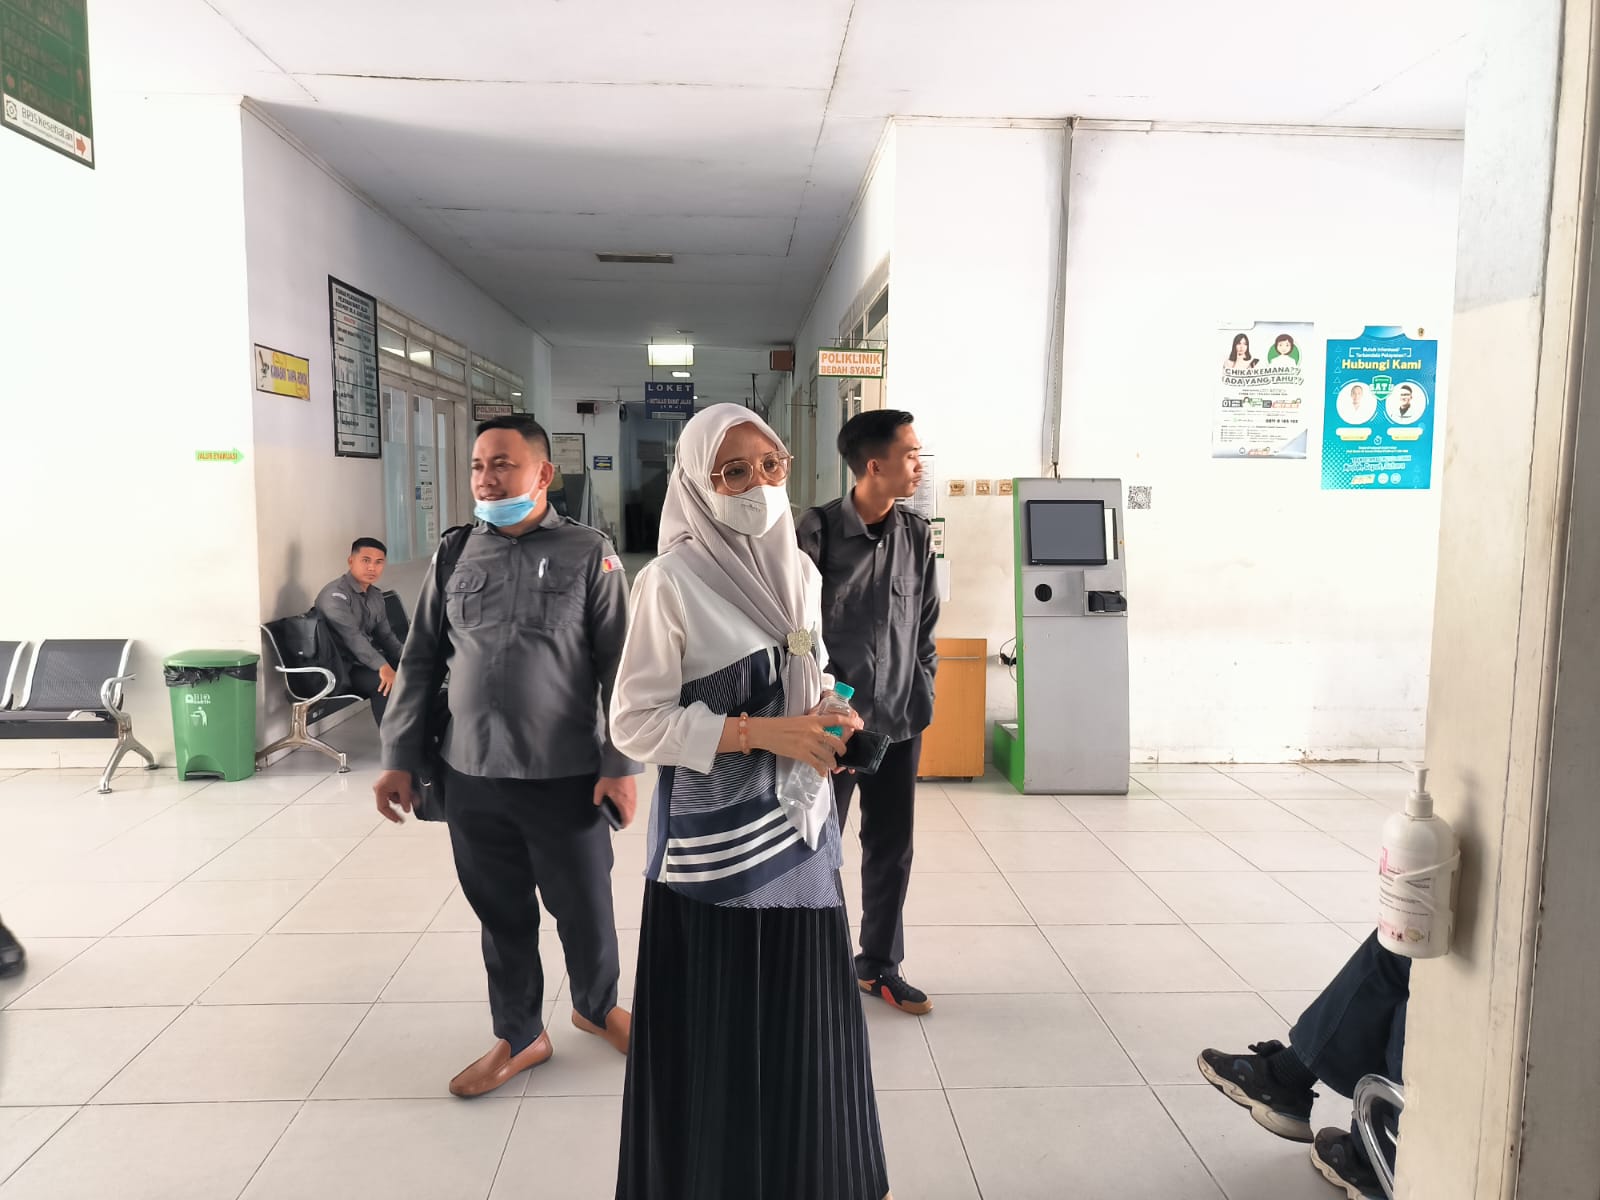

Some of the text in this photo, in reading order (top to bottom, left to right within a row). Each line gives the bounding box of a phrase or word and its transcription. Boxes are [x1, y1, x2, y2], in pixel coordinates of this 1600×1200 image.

[22, 107, 38, 123] BPJS
[38, 118, 73, 141] Kesehatan
[821, 353, 880, 364] POLIKLINIK
[1342, 359, 1422, 371] Hubungi Kami
[821, 366, 880, 375] BEDAH SYARAF
[1225, 368, 1252, 376] CHIKA
[1224, 377, 1244, 385] ADA
[1245, 377, 1270, 385] YANG
[647, 384, 692, 392] LOKET
